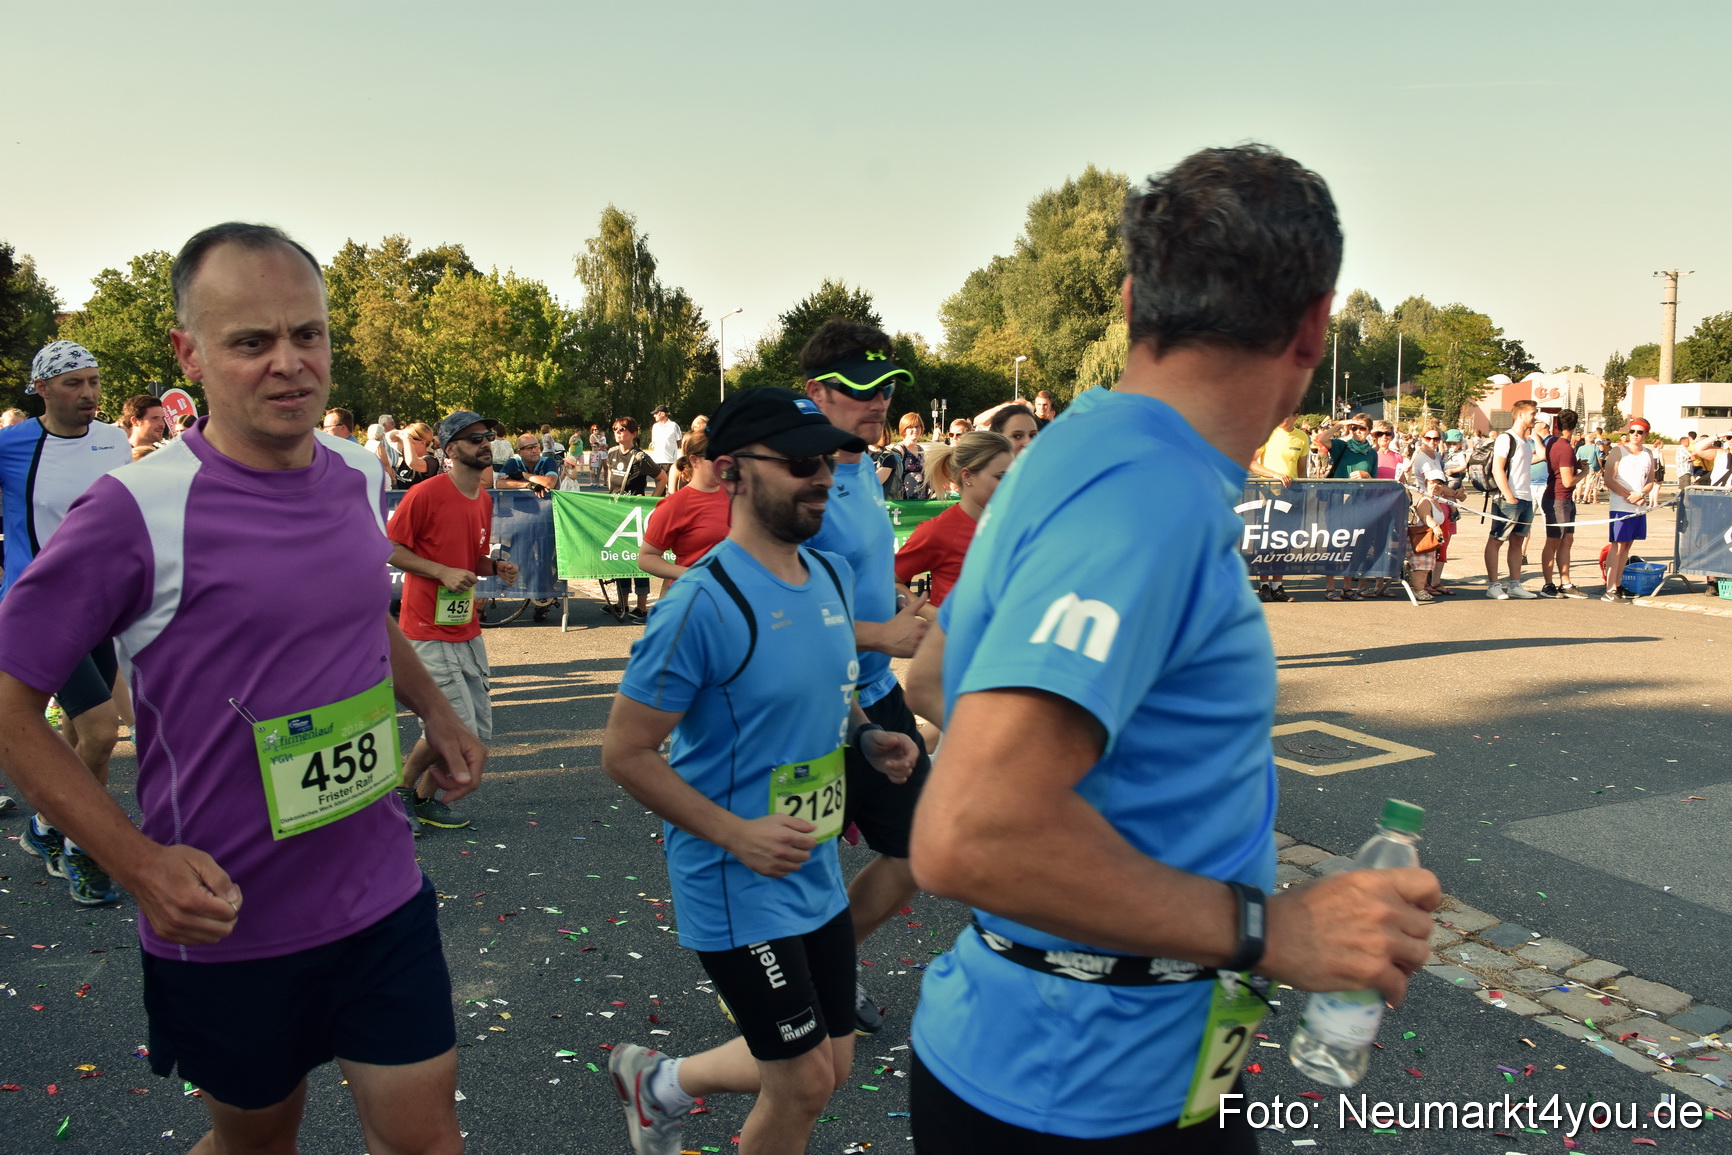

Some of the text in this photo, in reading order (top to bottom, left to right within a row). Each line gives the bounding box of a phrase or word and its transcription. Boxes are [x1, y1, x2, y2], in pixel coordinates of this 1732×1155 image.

[1241, 523, 1366, 550] Fischer
[600, 550, 619, 561] Die
[1251, 551, 1353, 564] AUTOMOBILE
[446, 600, 470, 614] 452
[280, 722, 334, 746] firmenlauf
[301, 732, 378, 792] 458
[318, 785, 354, 805] Frister
[355, 773, 374, 791] Ralf
[784, 779, 843, 821] 2128
[1211, 1026, 1248, 1080] 2
